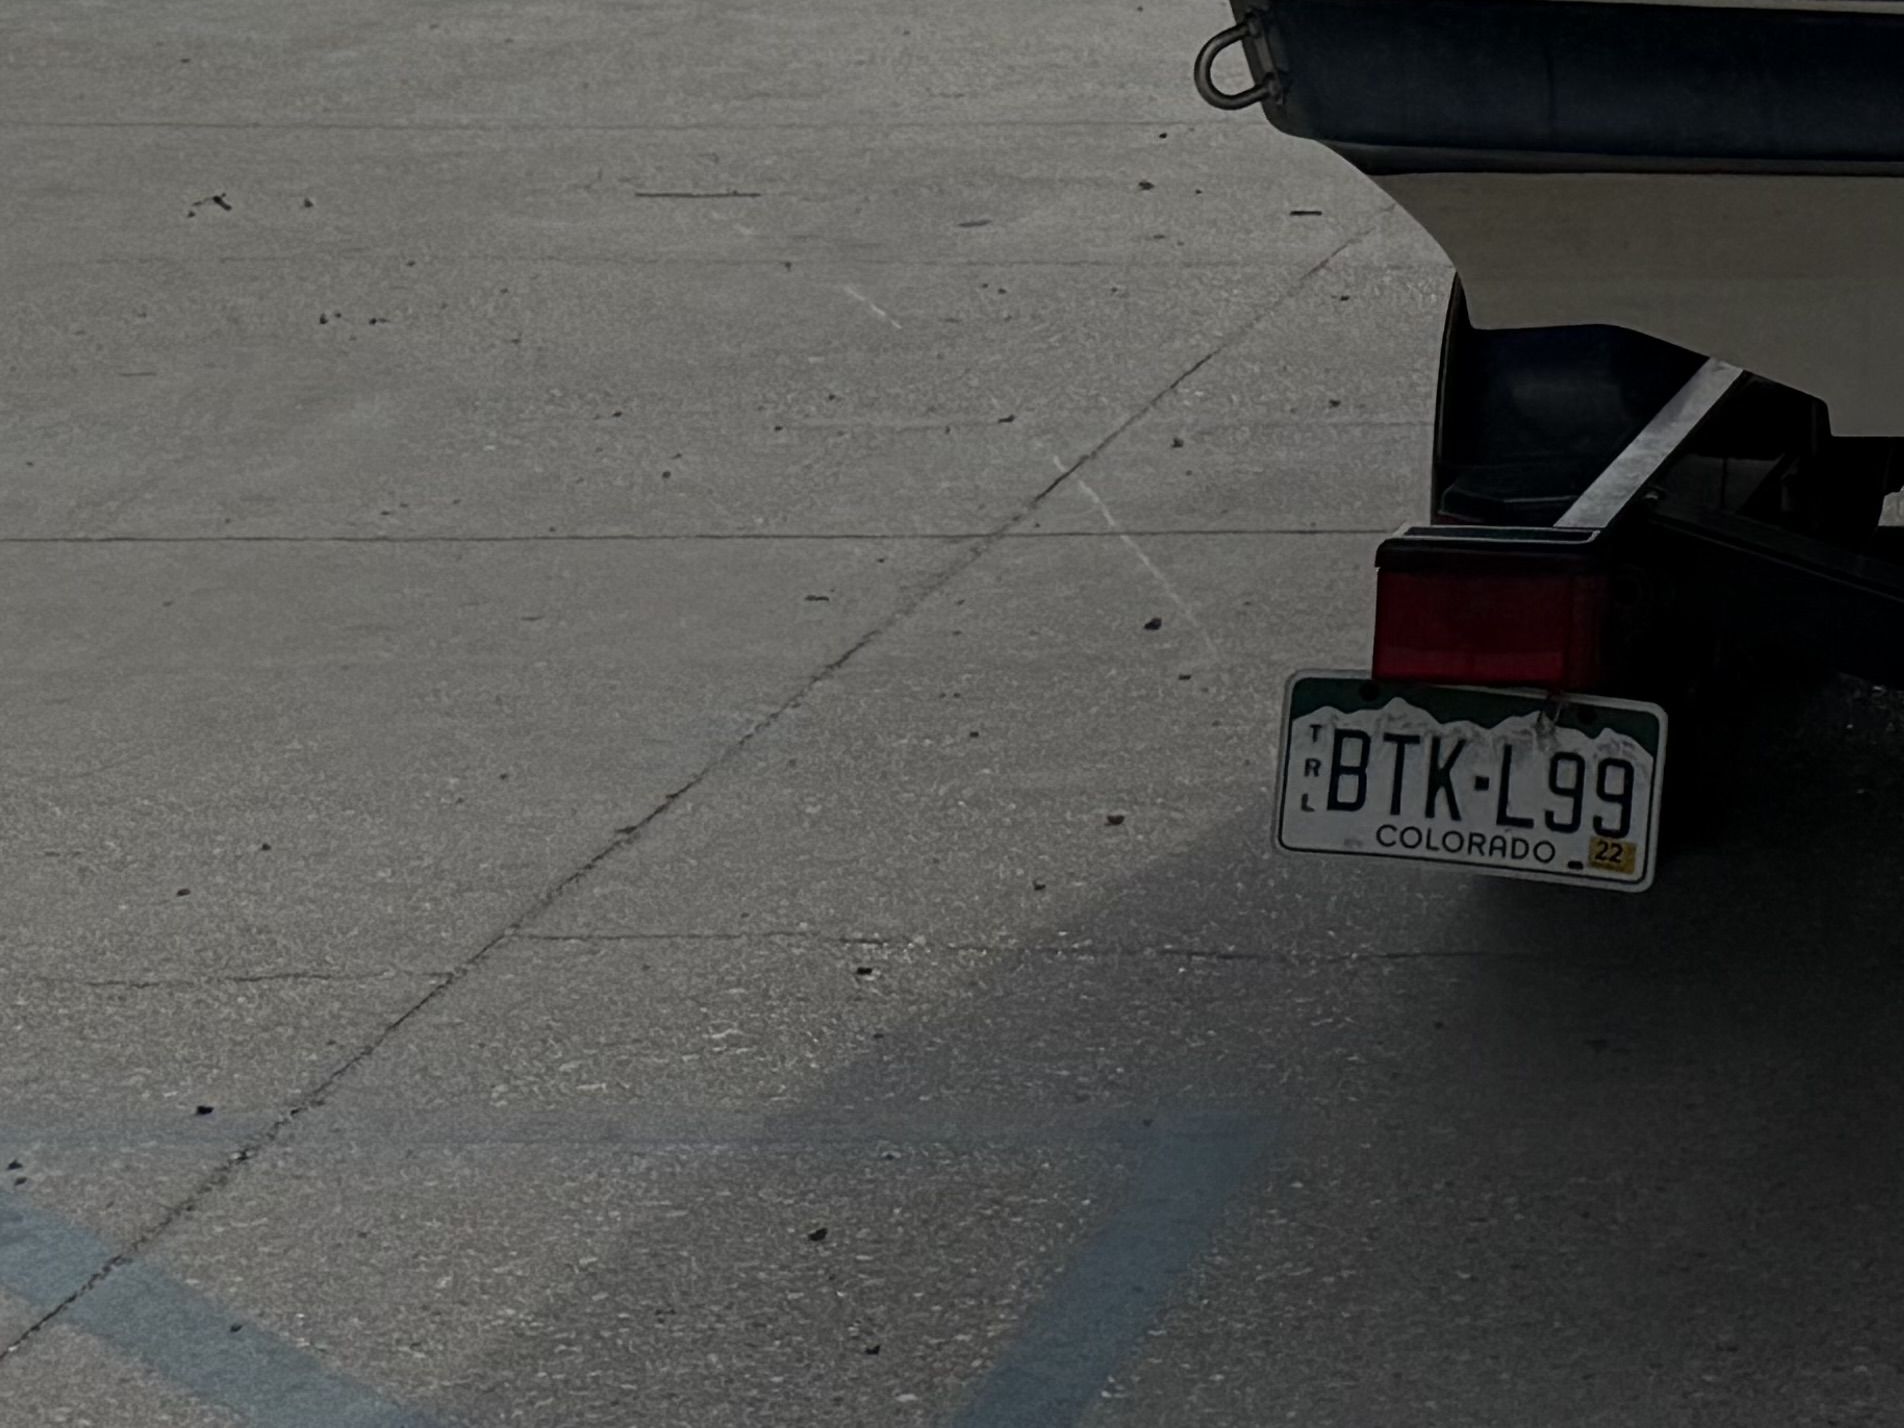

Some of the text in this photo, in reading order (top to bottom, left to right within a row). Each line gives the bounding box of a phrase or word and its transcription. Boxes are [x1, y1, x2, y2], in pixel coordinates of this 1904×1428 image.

[1326, 729, 1635, 839] BTK-L99
[1375, 823, 1556, 865] COLORADO
[1593, 842, 1623, 865] 22
